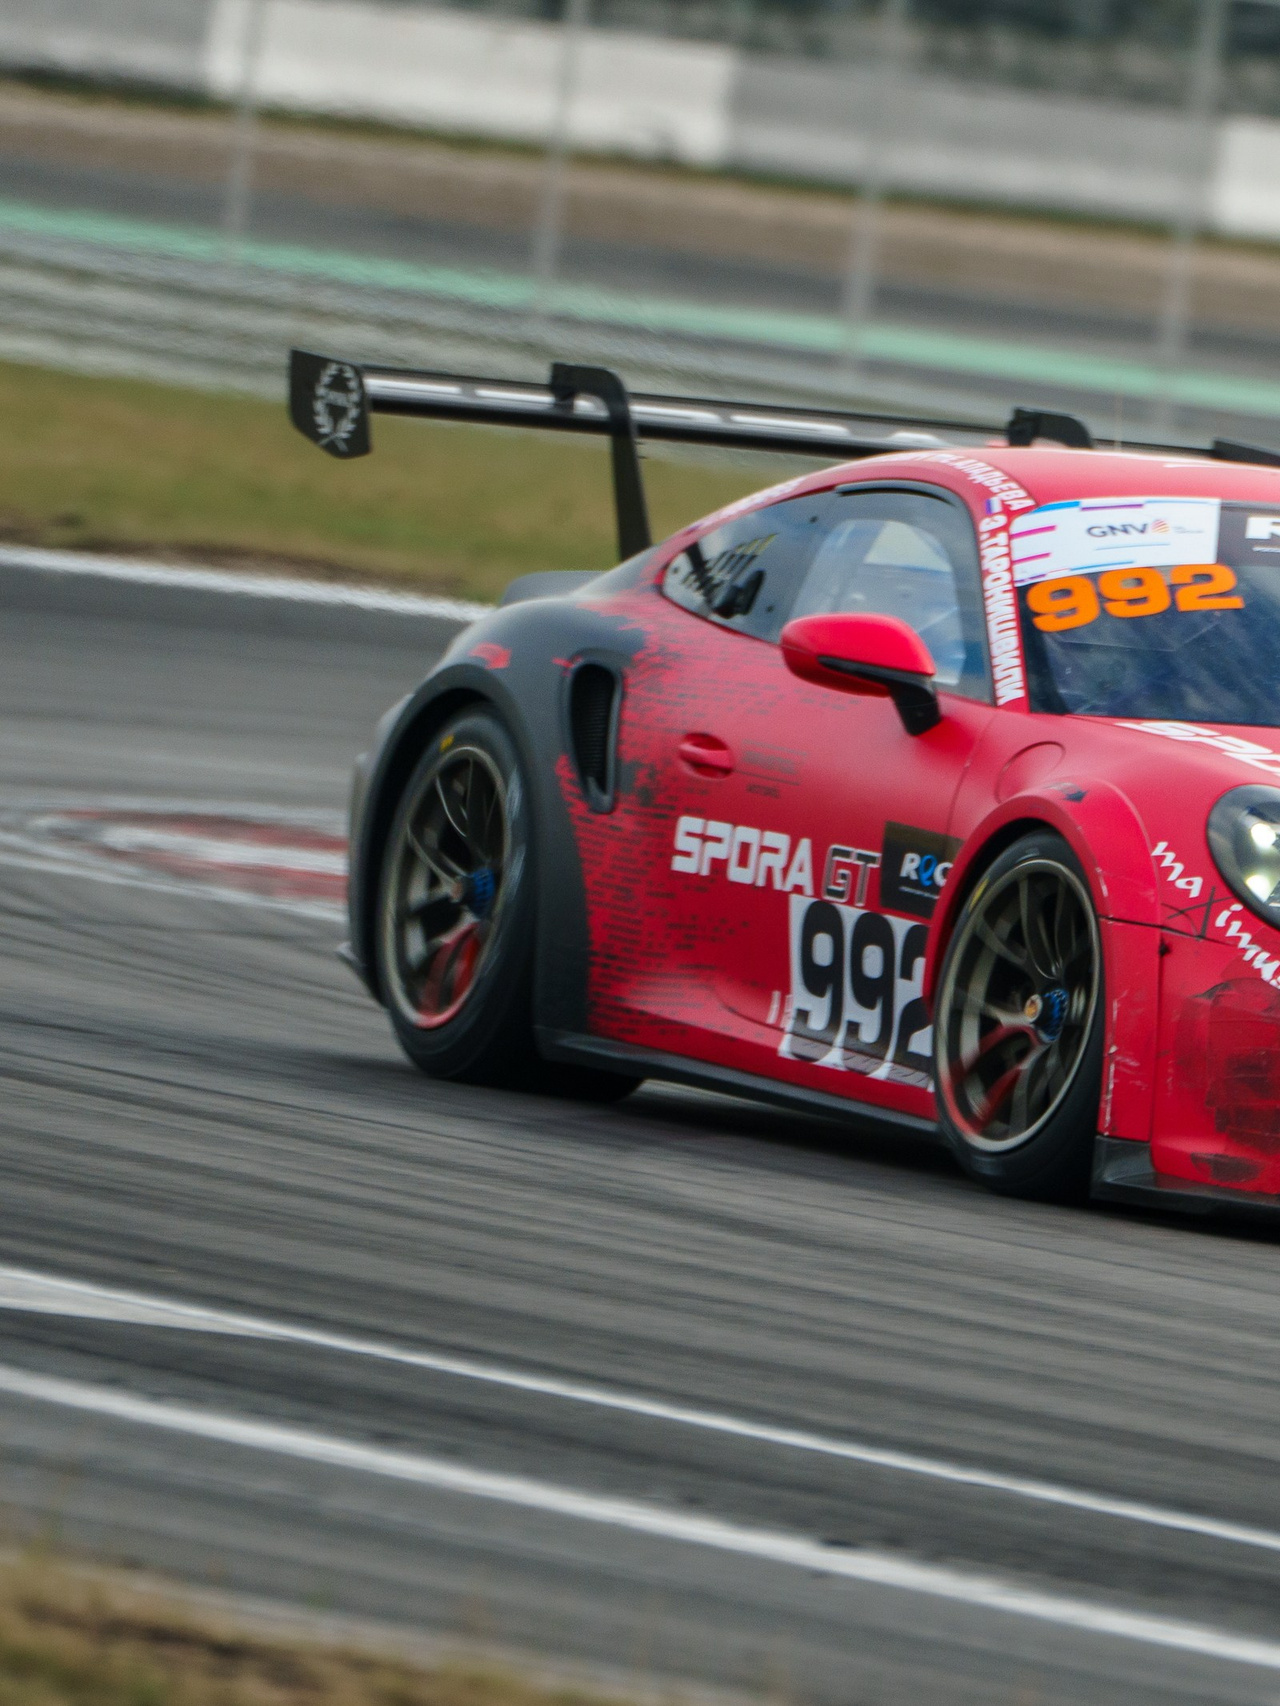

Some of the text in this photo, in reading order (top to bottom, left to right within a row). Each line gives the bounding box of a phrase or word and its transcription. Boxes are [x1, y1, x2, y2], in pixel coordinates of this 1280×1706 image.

[1087, 522, 1149, 537] GNV
[1026, 563, 1244, 632] 992
[671, 815, 882, 907] SPORA GT
[788, 900, 934, 1087] 992
